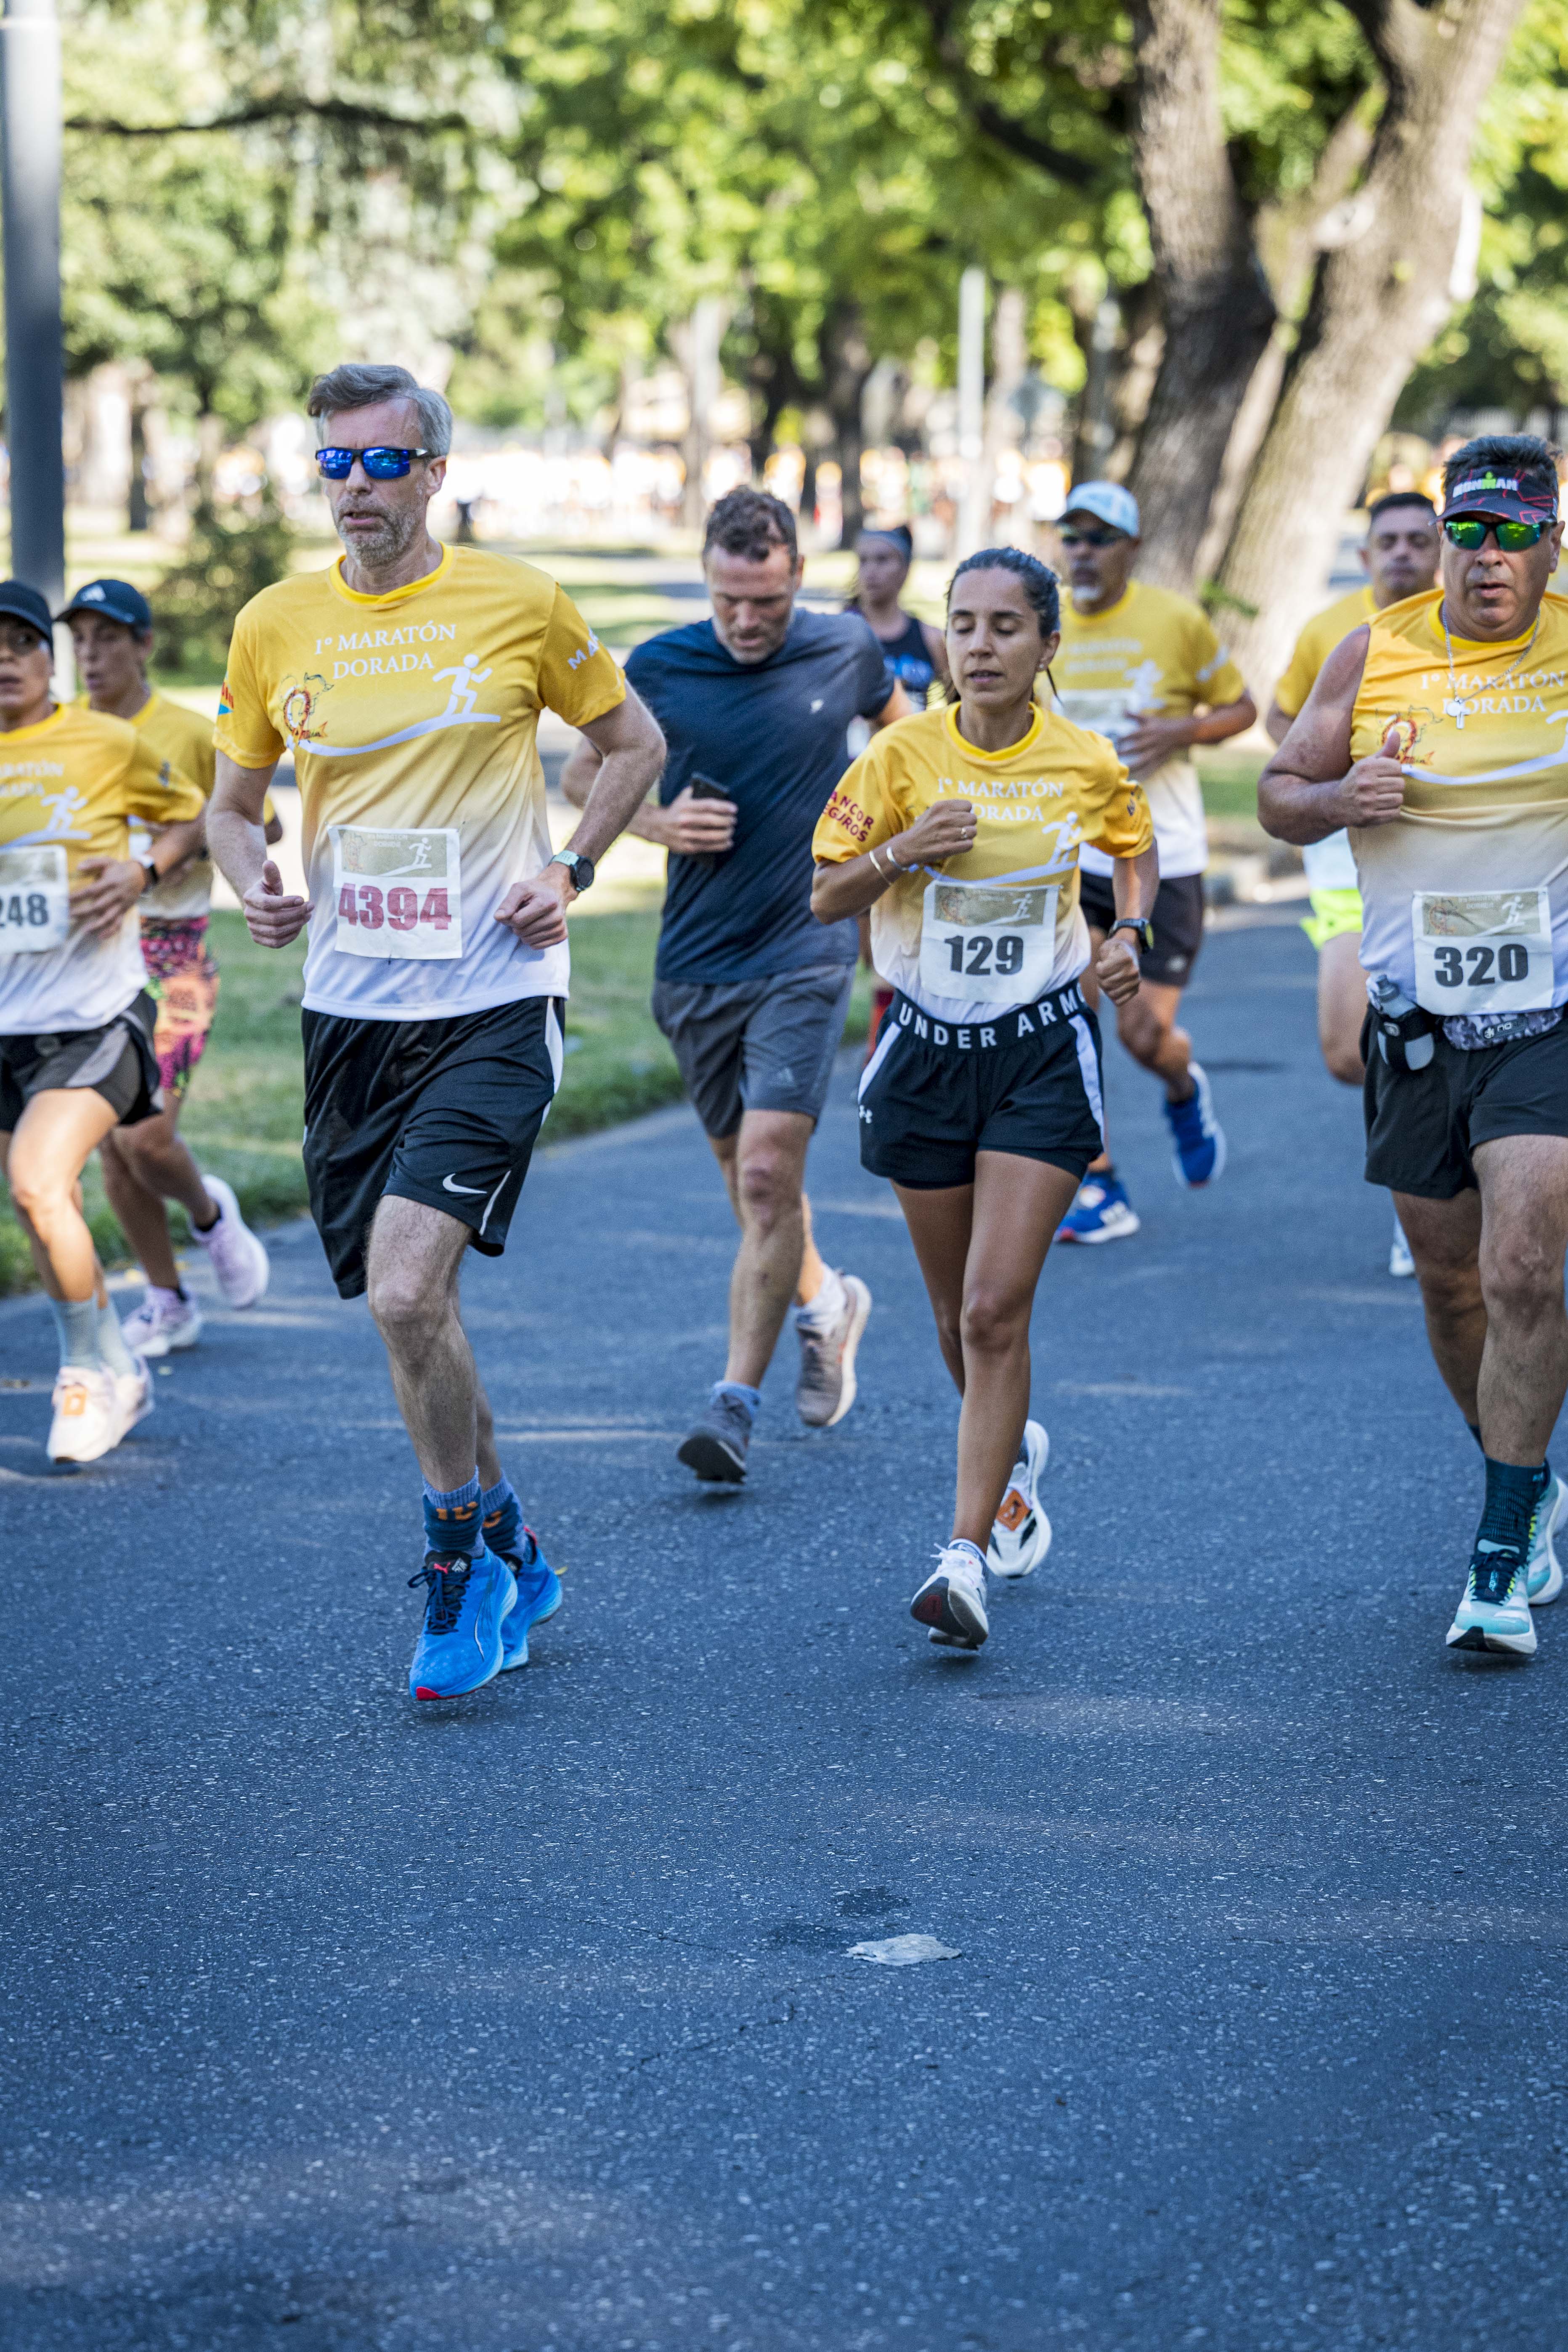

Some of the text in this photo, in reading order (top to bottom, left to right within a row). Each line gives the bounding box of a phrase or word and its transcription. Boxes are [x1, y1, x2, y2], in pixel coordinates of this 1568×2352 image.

[337, 620, 456, 651] MARATÓN
[333, 653, 434, 680] DORADA
[1445, 669, 1566, 690] MARATÓN
[958, 776, 1064, 798] MARATÓN
[971, 803, 1044, 821] ORADA
[338, 883, 451, 931] 4394
[944, 935, 1024, 976] 129
[1434, 943, 1528, 988] 320
[899, 1002, 998, 1049] UNDER
